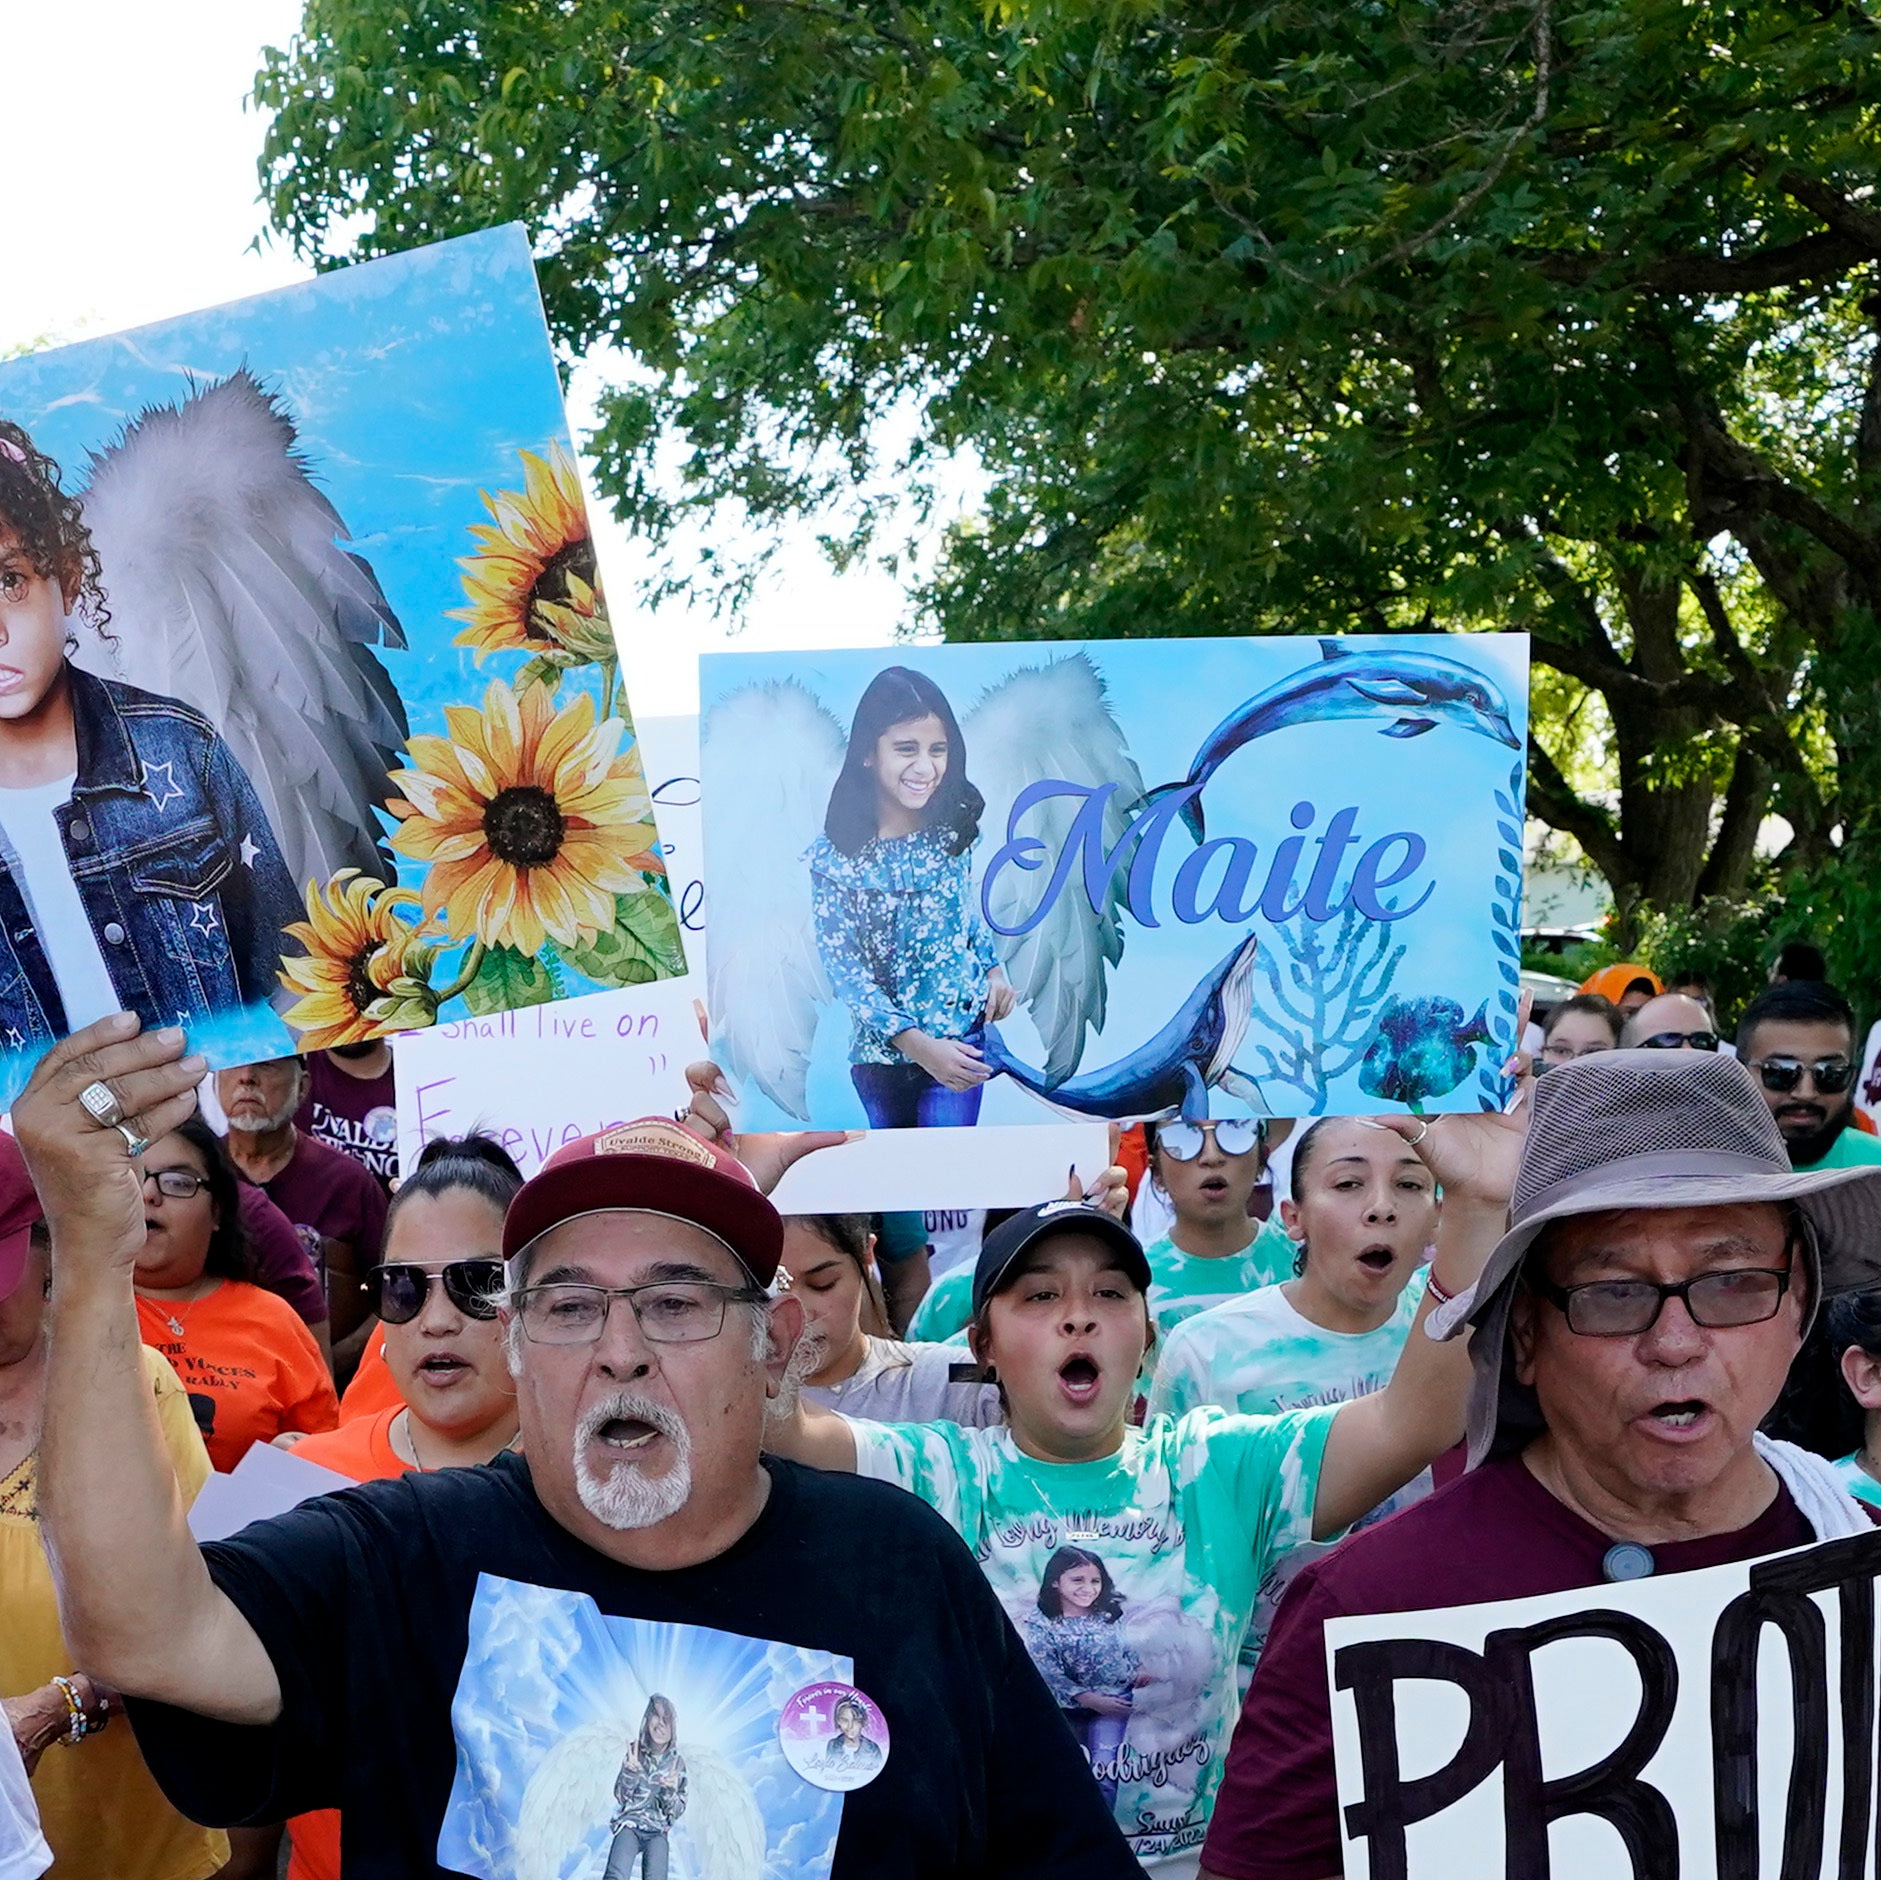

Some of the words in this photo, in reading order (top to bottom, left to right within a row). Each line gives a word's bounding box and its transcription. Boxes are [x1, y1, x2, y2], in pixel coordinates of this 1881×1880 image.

[981, 778, 1437, 937] Maite
[537, 1005, 598, 1038] live
[617, 1013, 659, 1038] on
